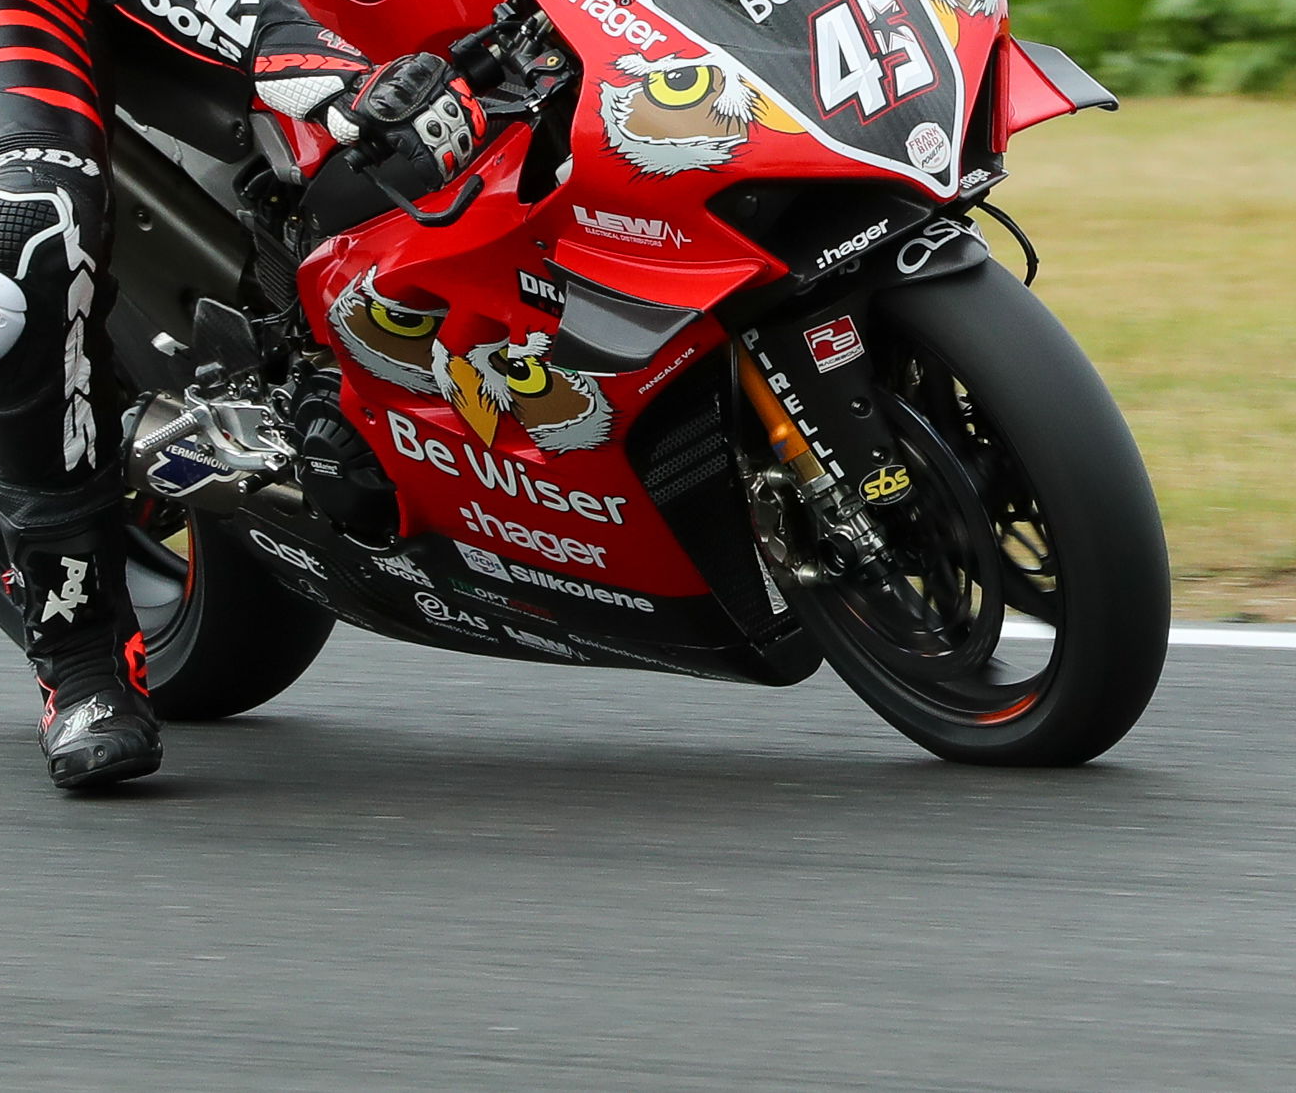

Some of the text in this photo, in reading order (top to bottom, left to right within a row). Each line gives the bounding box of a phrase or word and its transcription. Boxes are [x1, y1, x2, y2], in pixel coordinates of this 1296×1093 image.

[909, 126, 939, 150] FRANK
[918, 137, 939, 154] BIRD
[573, 205, 663, 238] LEW
[741, 327, 845, 479] PIRELLI
[387, 409, 628, 524] Be Wiser
[863, 468, 910, 501] sbs
[374, 563, 433, 589] TOOLS
[506, 563, 656, 613] Silkolene
